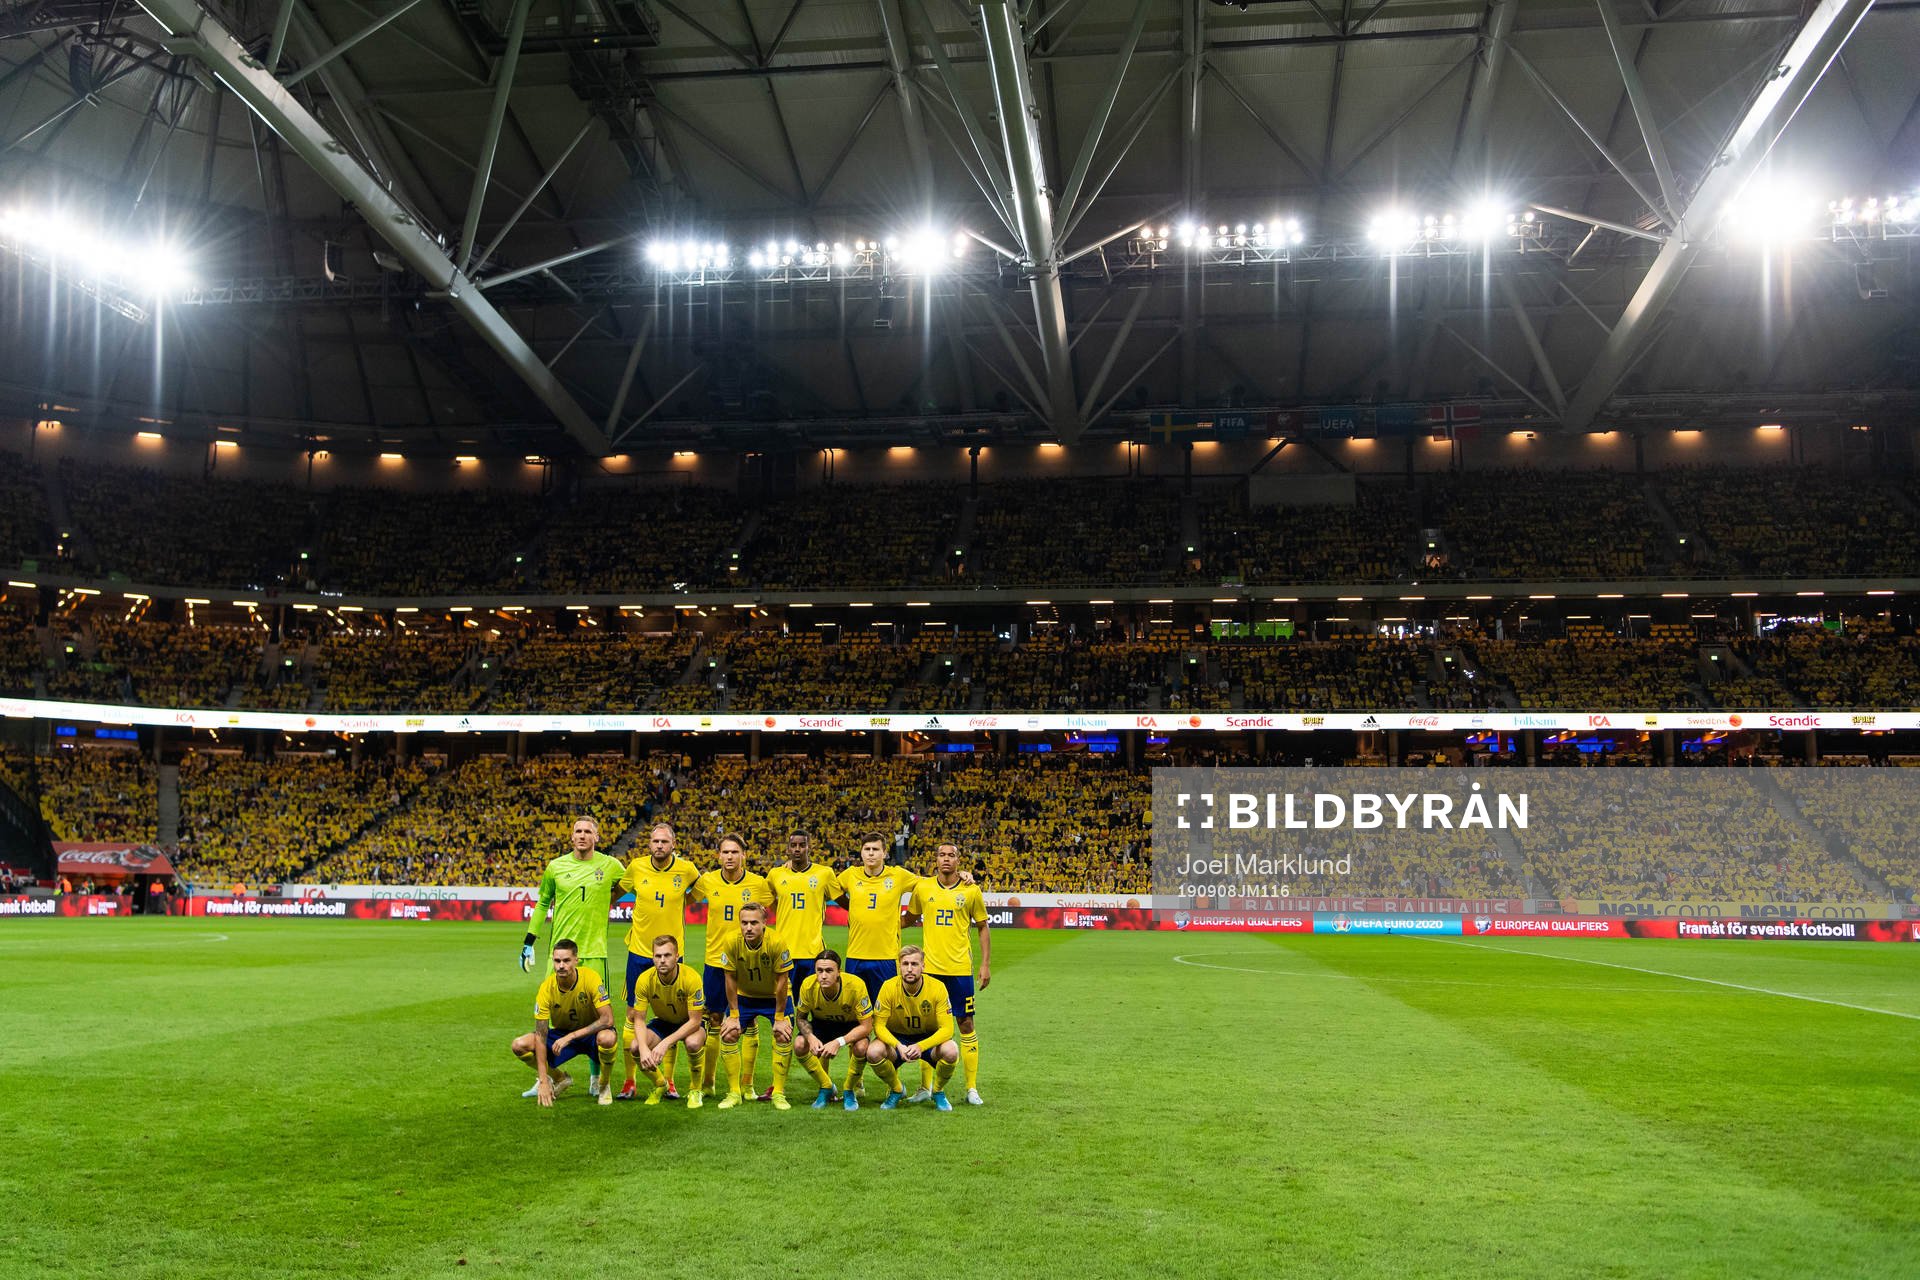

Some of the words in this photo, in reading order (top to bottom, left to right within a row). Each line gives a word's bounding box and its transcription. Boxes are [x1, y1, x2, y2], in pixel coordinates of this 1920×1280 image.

[1219, 417, 1245, 427] FIFA
[1322, 419, 1355, 430] UEFA
[176, 713, 195, 723] ICA
[653, 717, 671, 728] ICA
[799, 717, 843, 728] Scandic
[1067, 717, 1107, 727] Folksam
[1136, 716, 1157, 727] ICA
[1226, 716, 1273, 727] Scandic
[1514, 715, 1557, 726] Folksam
[1588, 715, 1612, 727] ICA
[1769, 715, 1821, 726] Scandic
[303, 887, 326, 899] ICA
[371, 888, 458, 900] icase/hälsa
[508, 891, 531, 901] ICA
[580, 886, 586, 902] 1
[655, 891, 665, 908] 4
[790, 893, 805, 910] 15
[867, 893, 877, 909] 3
[1056, 898, 1122, 908] Swedbank
[207, 899, 243, 914] Framåt
[245, 900, 261, 914] för
[262, 901, 301, 915] svensk
[303, 901, 345, 915] fotboll!
[724, 905, 734, 921] 8
[936, 909, 954, 926] 22
[1193, 916, 1244, 926] EUROPEAN
[1247, 917, 1303, 927] QUALIFIERS
[1353, 918, 1383, 928] UEFA
[1384, 919, 1414, 929] EURO
[1415, 919, 1443, 929] 2020
[1494, 920, 1548, 931] EUROPEAN
[1551, 921, 1609, 931] QUALIFIERS
[1679, 920, 1725, 935] Framåt
[1727, 921, 1748, 936] för
[1749, 922, 1799, 936] svensk
[1801, 923, 1855, 937] fotboll!
[667, 1003, 677, 1014] 7
[569, 1008, 579, 1022] 2
[905, 1016, 921, 1029] 10
